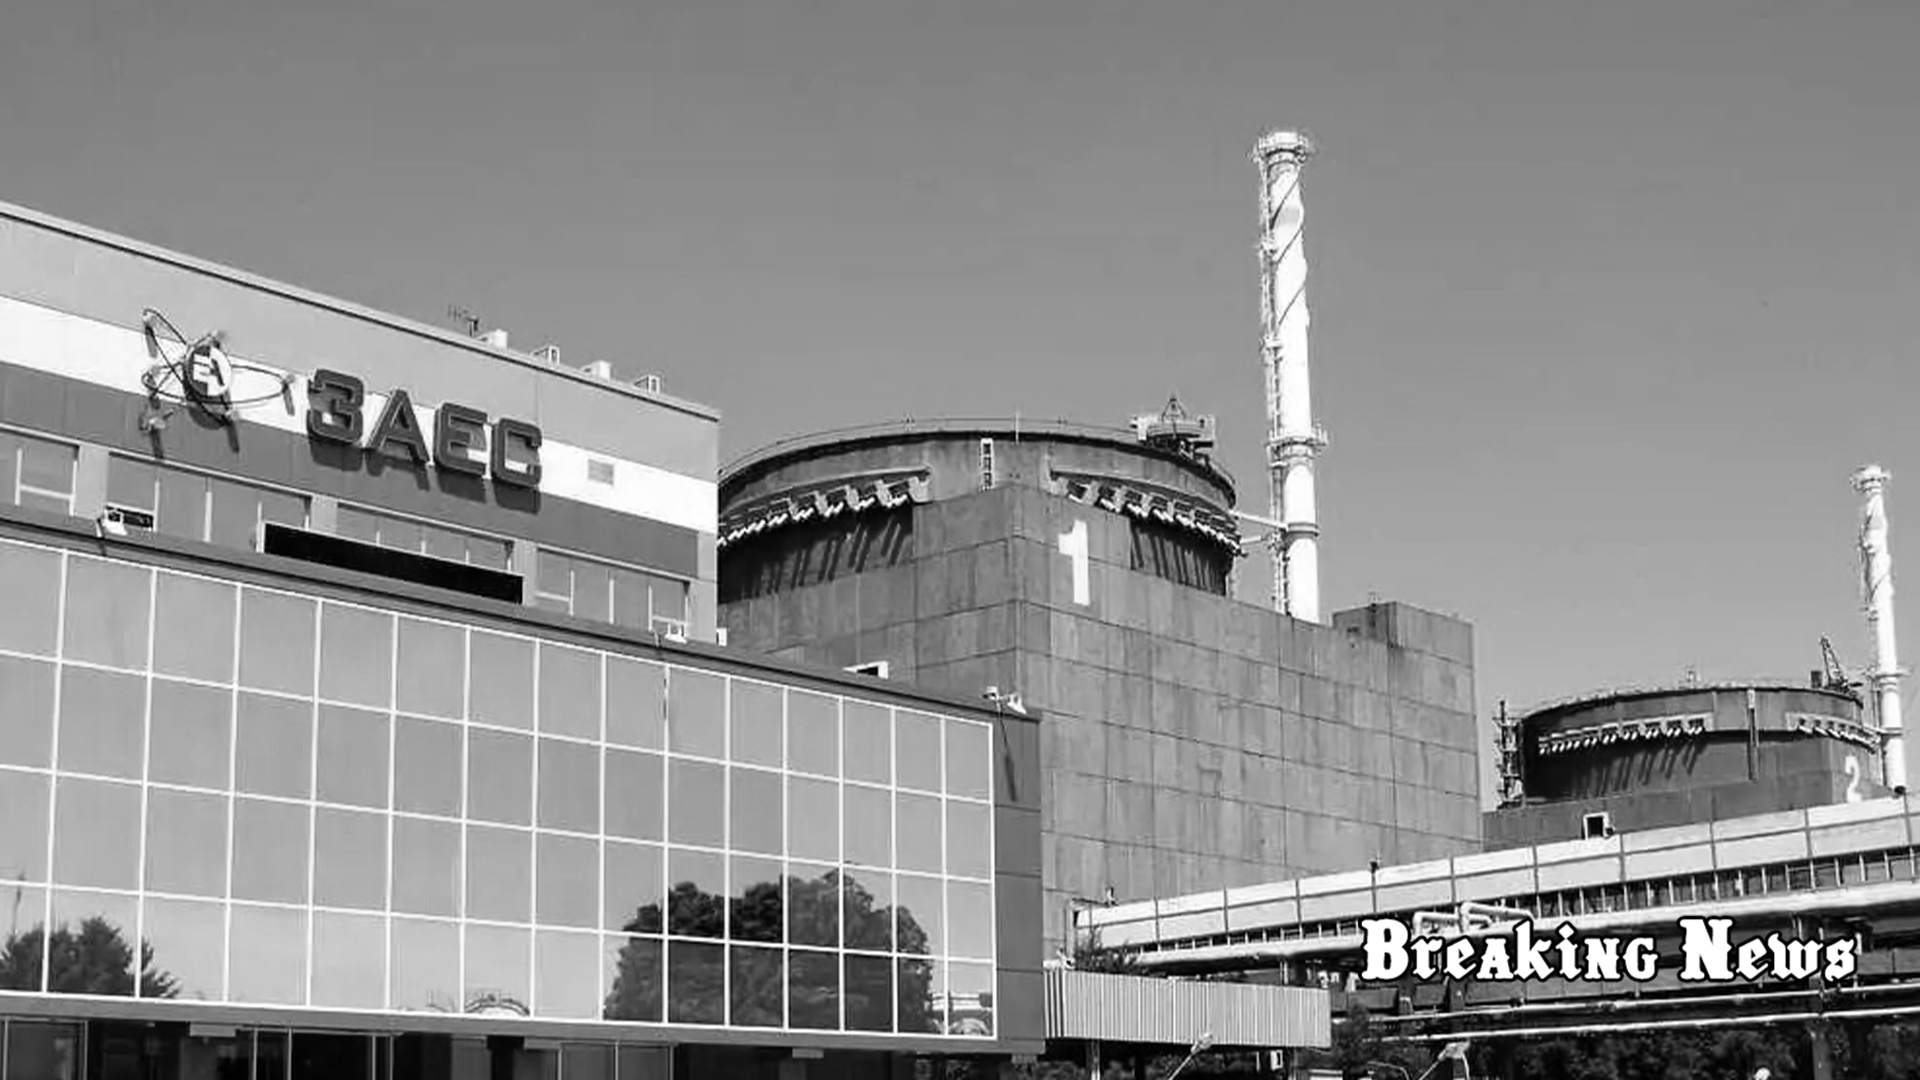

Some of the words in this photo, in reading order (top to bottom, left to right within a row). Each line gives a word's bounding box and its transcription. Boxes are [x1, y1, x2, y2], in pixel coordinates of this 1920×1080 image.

[307, 369, 542, 487] ЗАЕС
[1059, 520, 1090, 606] 1
[1845, 755, 1861, 802] 2
